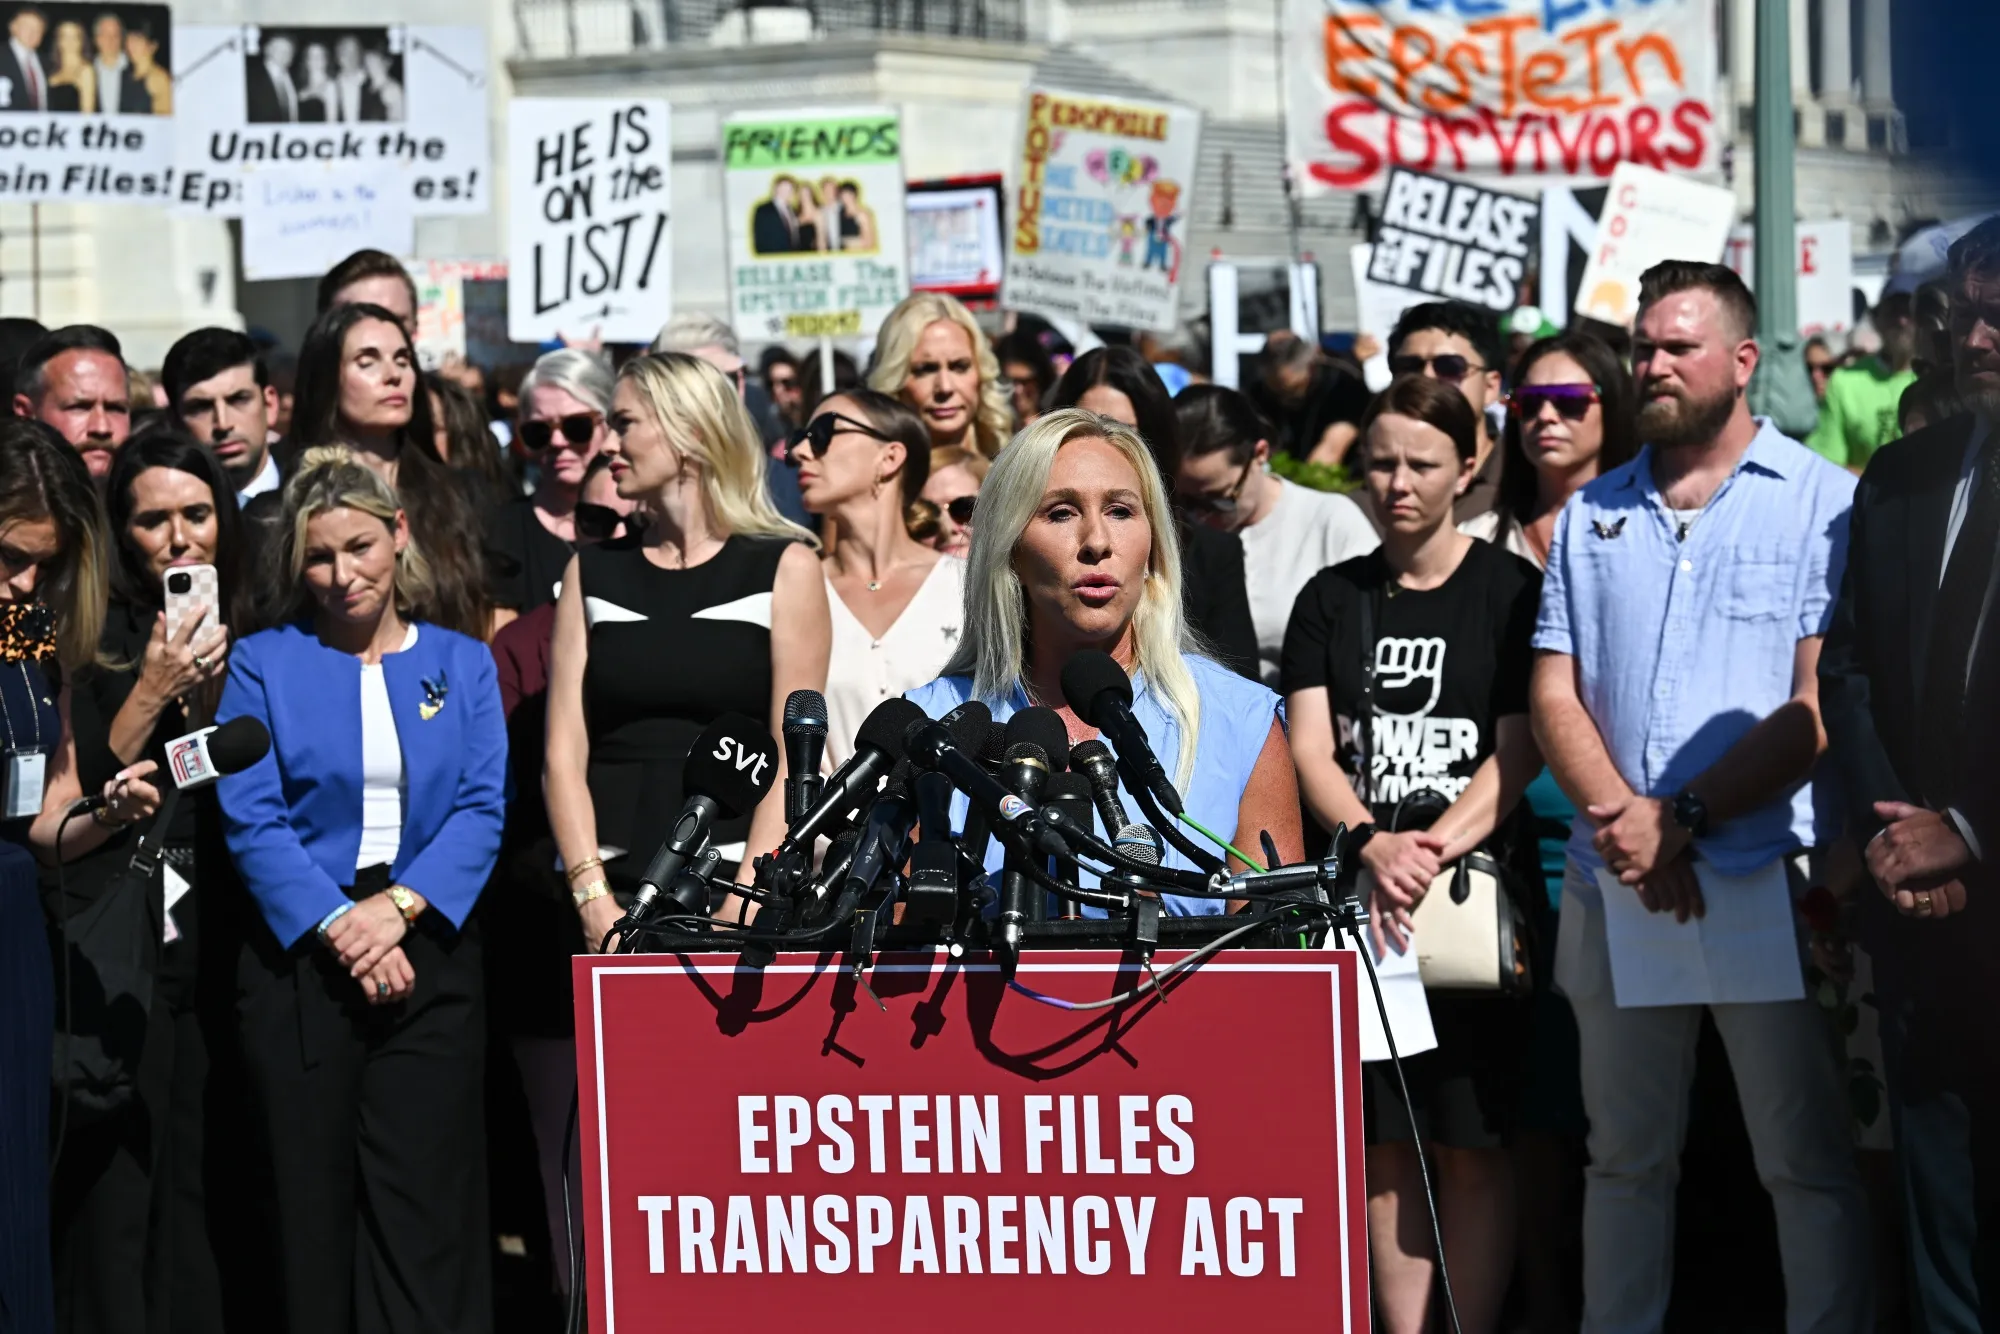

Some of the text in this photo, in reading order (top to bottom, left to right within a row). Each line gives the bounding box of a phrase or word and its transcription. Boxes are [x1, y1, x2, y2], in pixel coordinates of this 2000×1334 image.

[81, 122, 145, 151] the
[209, 130, 446, 162] Unlock the
[535, 105, 651, 185] HE IS
[726, 121, 899, 162] FRIENDS
[62, 163, 173, 196] Files!
[543, 161, 663, 223] ON the
[1383, 170, 1538, 257] RELEASE
[534, 211, 669, 316] LIST!
[1395, 230, 1523, 311] FILES
[712, 736, 769, 786] svt
[737, 1094, 1195, 1175] EPSTEIN FILES
[637, 1194, 1304, 1277] TRANSPARENCY ACT
